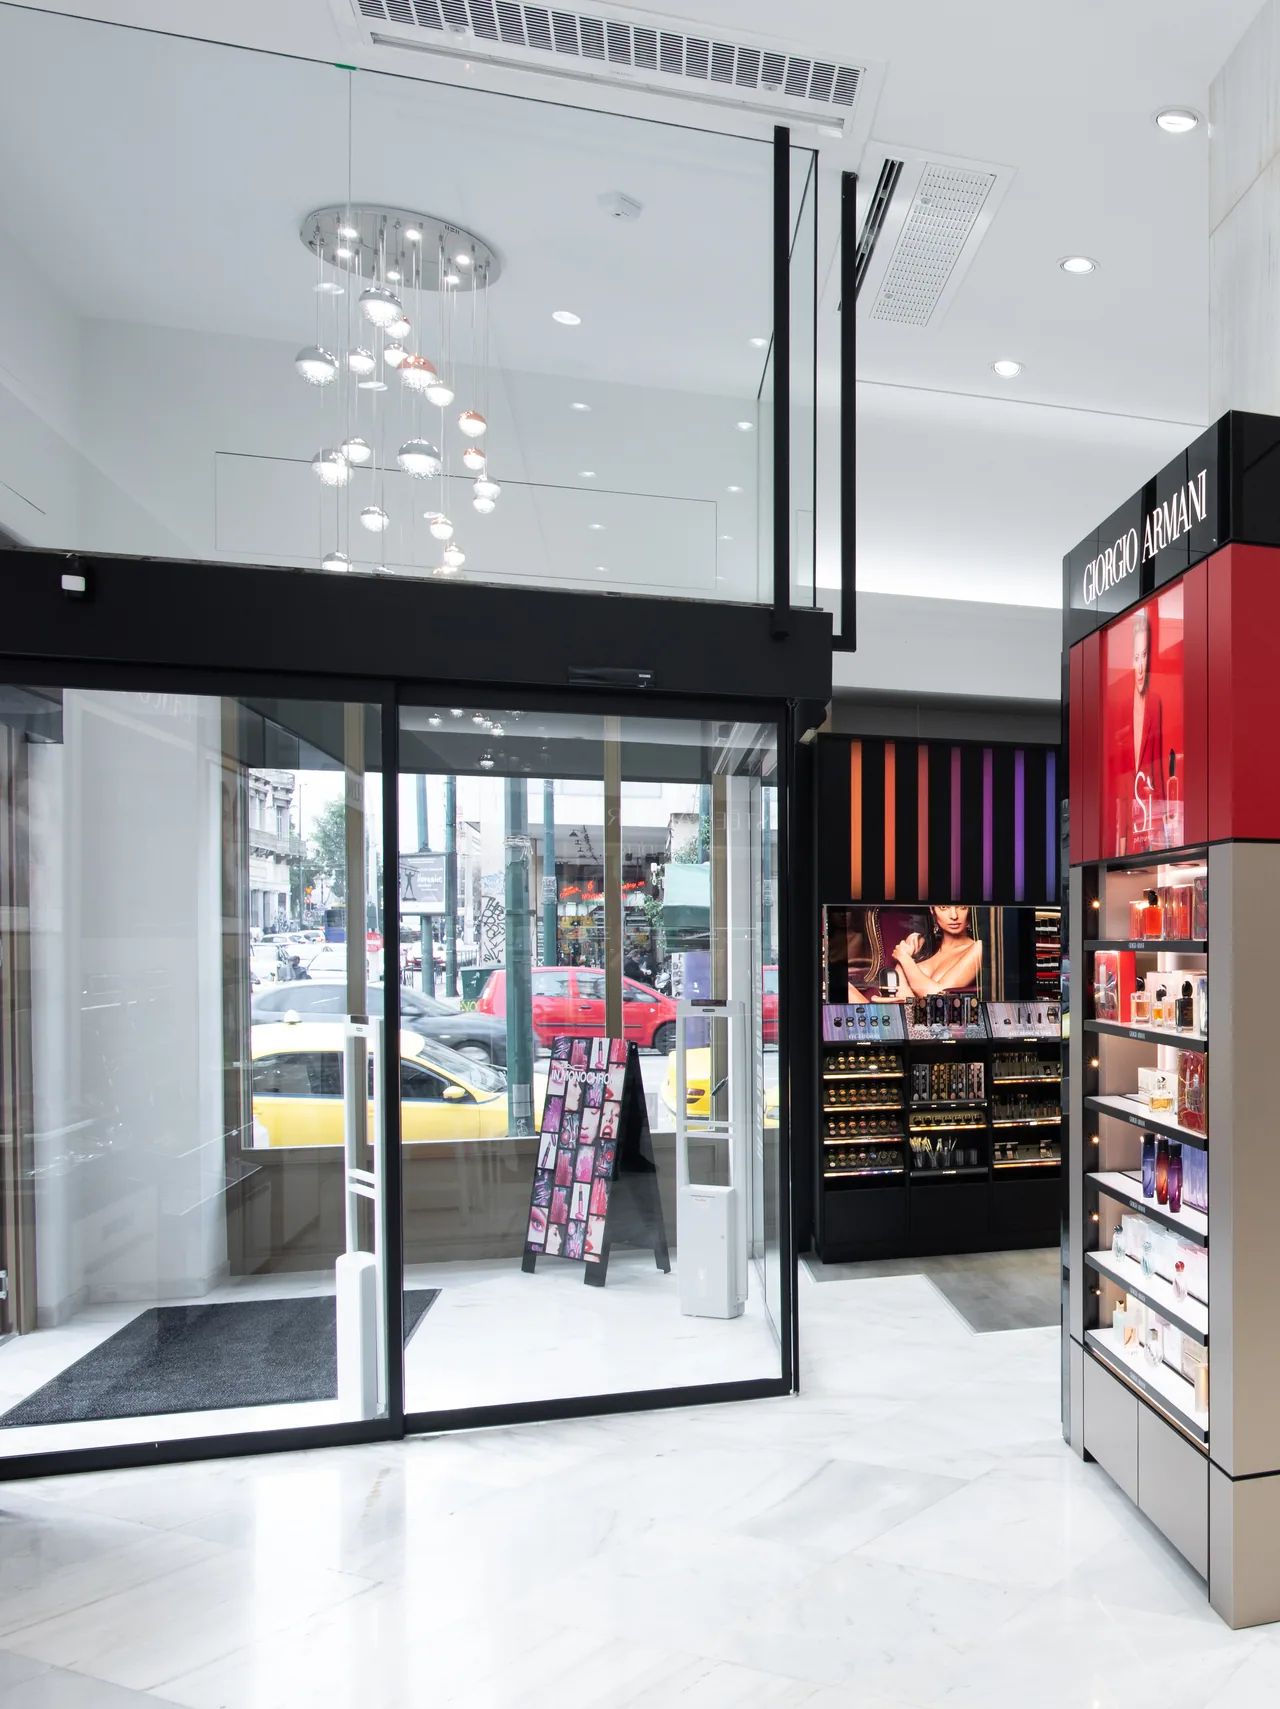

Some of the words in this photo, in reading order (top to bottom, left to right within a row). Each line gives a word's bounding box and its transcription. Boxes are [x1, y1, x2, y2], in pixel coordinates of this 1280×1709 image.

[1083, 528, 1138, 605] GIORGIO
[1142, 469, 1207, 563] ARMANI
[551, 1070, 560, 1081] IN
